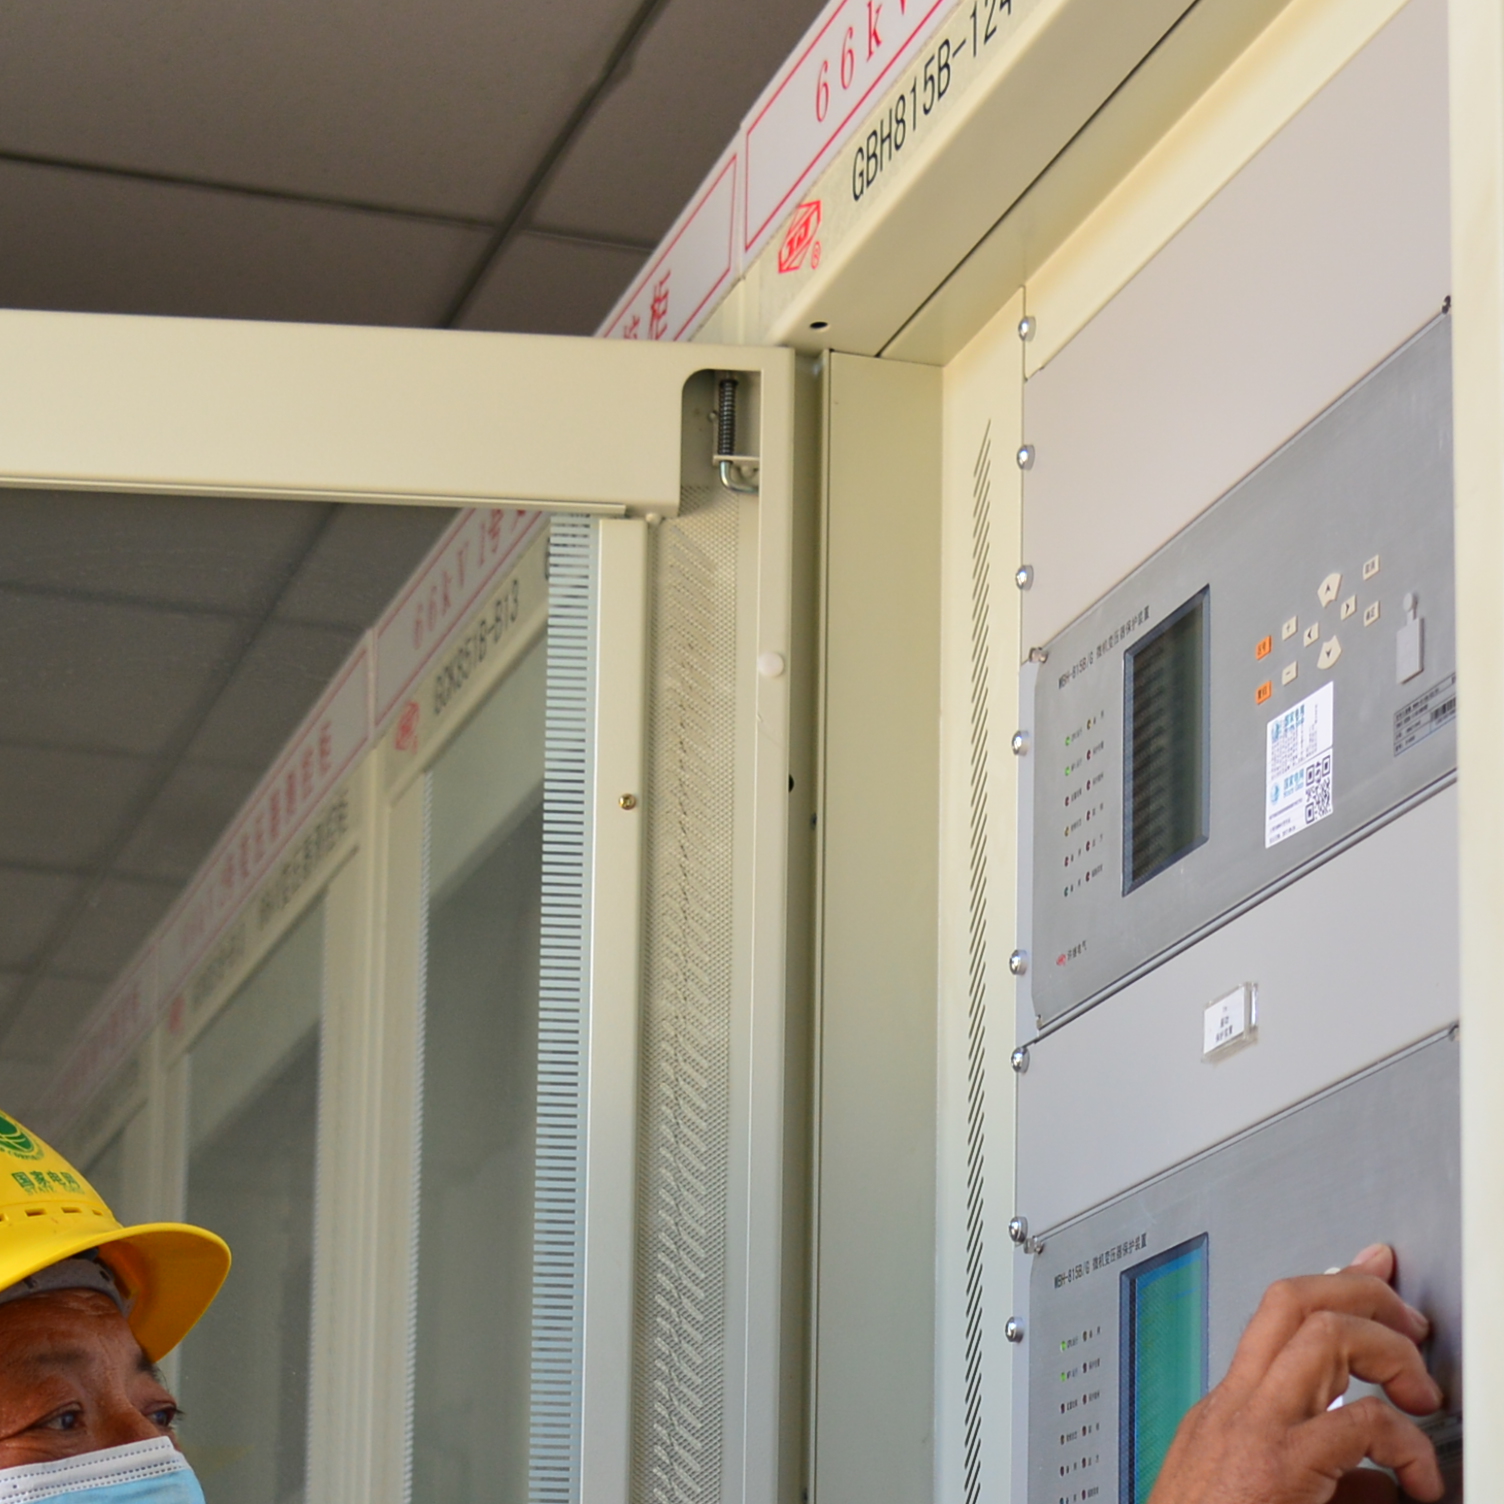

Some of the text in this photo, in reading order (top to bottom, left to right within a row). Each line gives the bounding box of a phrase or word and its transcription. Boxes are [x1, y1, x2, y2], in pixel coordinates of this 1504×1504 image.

[815, 0, 907, 123] 66k
[852, 0, 1012, 202] GBH815B-12
[11, 1169, 81, 1190] 国家电网
